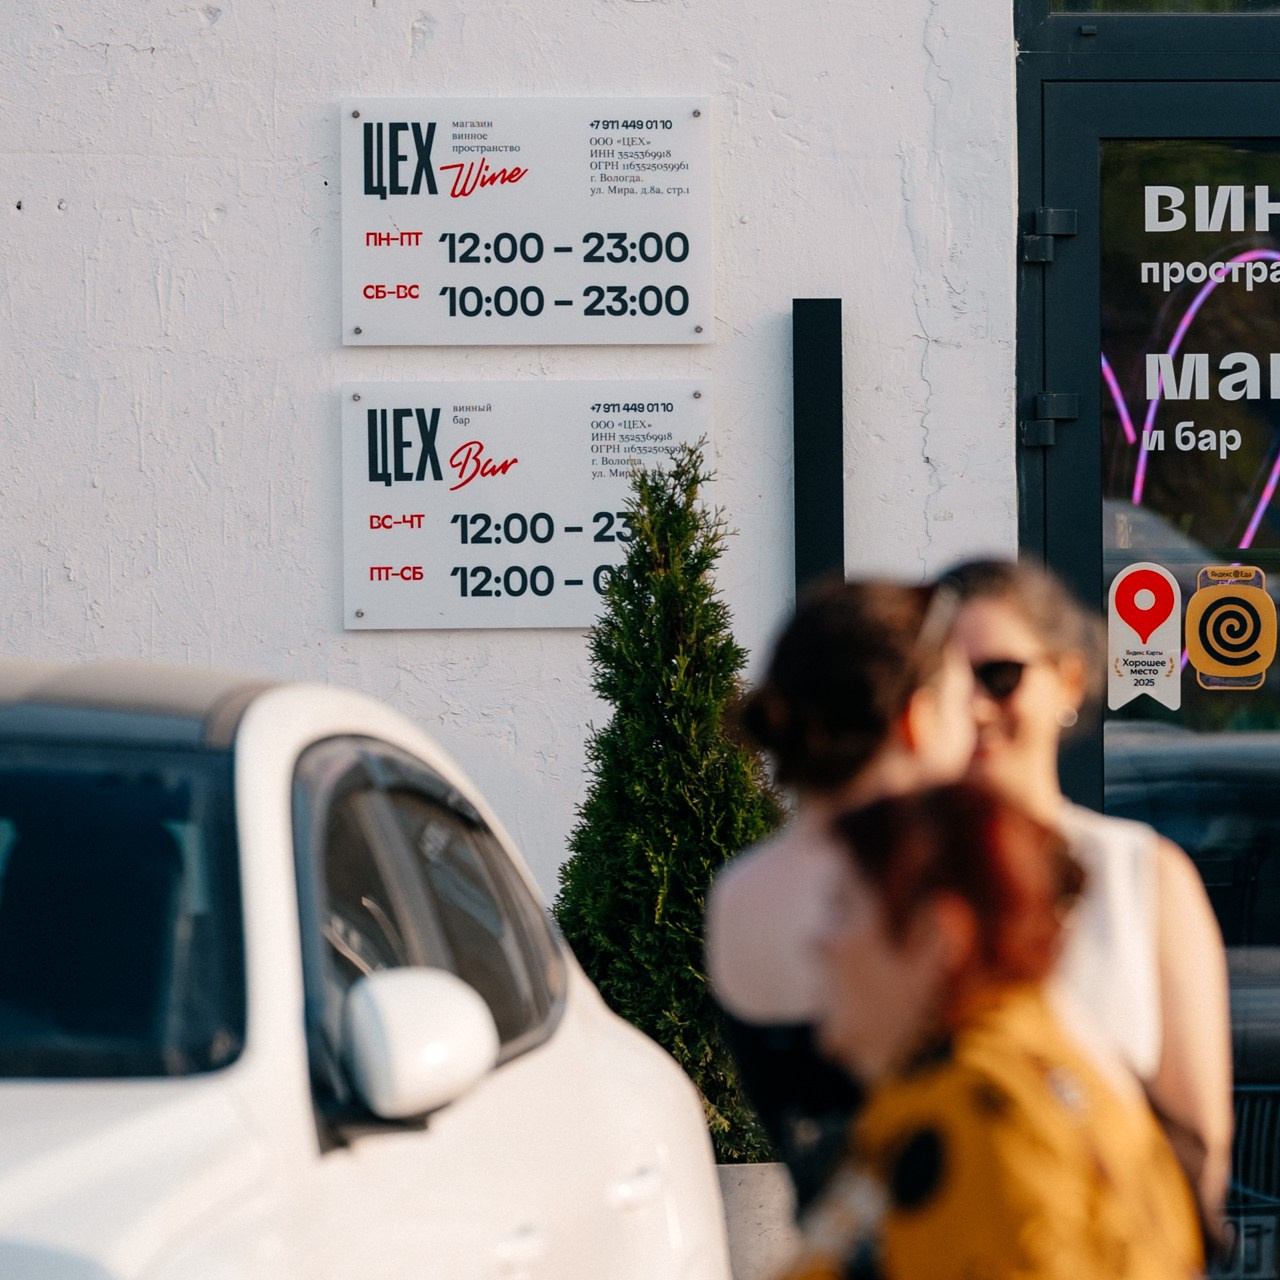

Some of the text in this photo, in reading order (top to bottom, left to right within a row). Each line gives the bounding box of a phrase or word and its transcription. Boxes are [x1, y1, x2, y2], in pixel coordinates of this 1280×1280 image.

[589, 120, 673, 130] +7 911 449 01 10
[590, 137, 651, 148] ООО «ЦЕХ»
[452, 145, 521, 154] пространство
[590, 150, 672, 160] ИНН 3525369918
[363, 122, 438, 200] ЦЕХ
[590, 161, 689, 172] ОГРН 1163525059961
[440, 157, 529, 198] Wine
[590, 187, 604, 196] ул.
[366, 232, 422, 246] ПН-ПТ
[438, 232, 544, 264] 12:00
[582, 232, 690, 264] 23:00
[363, 284, 420, 299] СБ-ВС
[438, 286, 545, 317] 10:00
[583, 285, 690, 316] 23:00
[453, 404, 492, 412] винный
[590, 402, 674, 412] +7 911 449 01 10
[452, 416, 470, 426] бар
[590, 420, 652, 430] ООО «ЦЕХ»
[592, 432, 672, 443] ИНН 3525369918
[1142, 422, 1242, 460] и бар
[368, 408, 444, 486] ЦЕХ
[590, 444, 620, 453] ОГРН
[450, 441, 518, 491] Bar
[591, 470, 606, 480] ул.
[370, 514, 424, 529] ВС-ЧТ
[450, 512, 554, 544] 12:00
[370, 566, 424, 581] ПТ-СБ
[450, 566, 554, 597] 12:00
[1122, 658, 1166, 668] Хорошее
[1134, 678, 1155, 686] 2025
